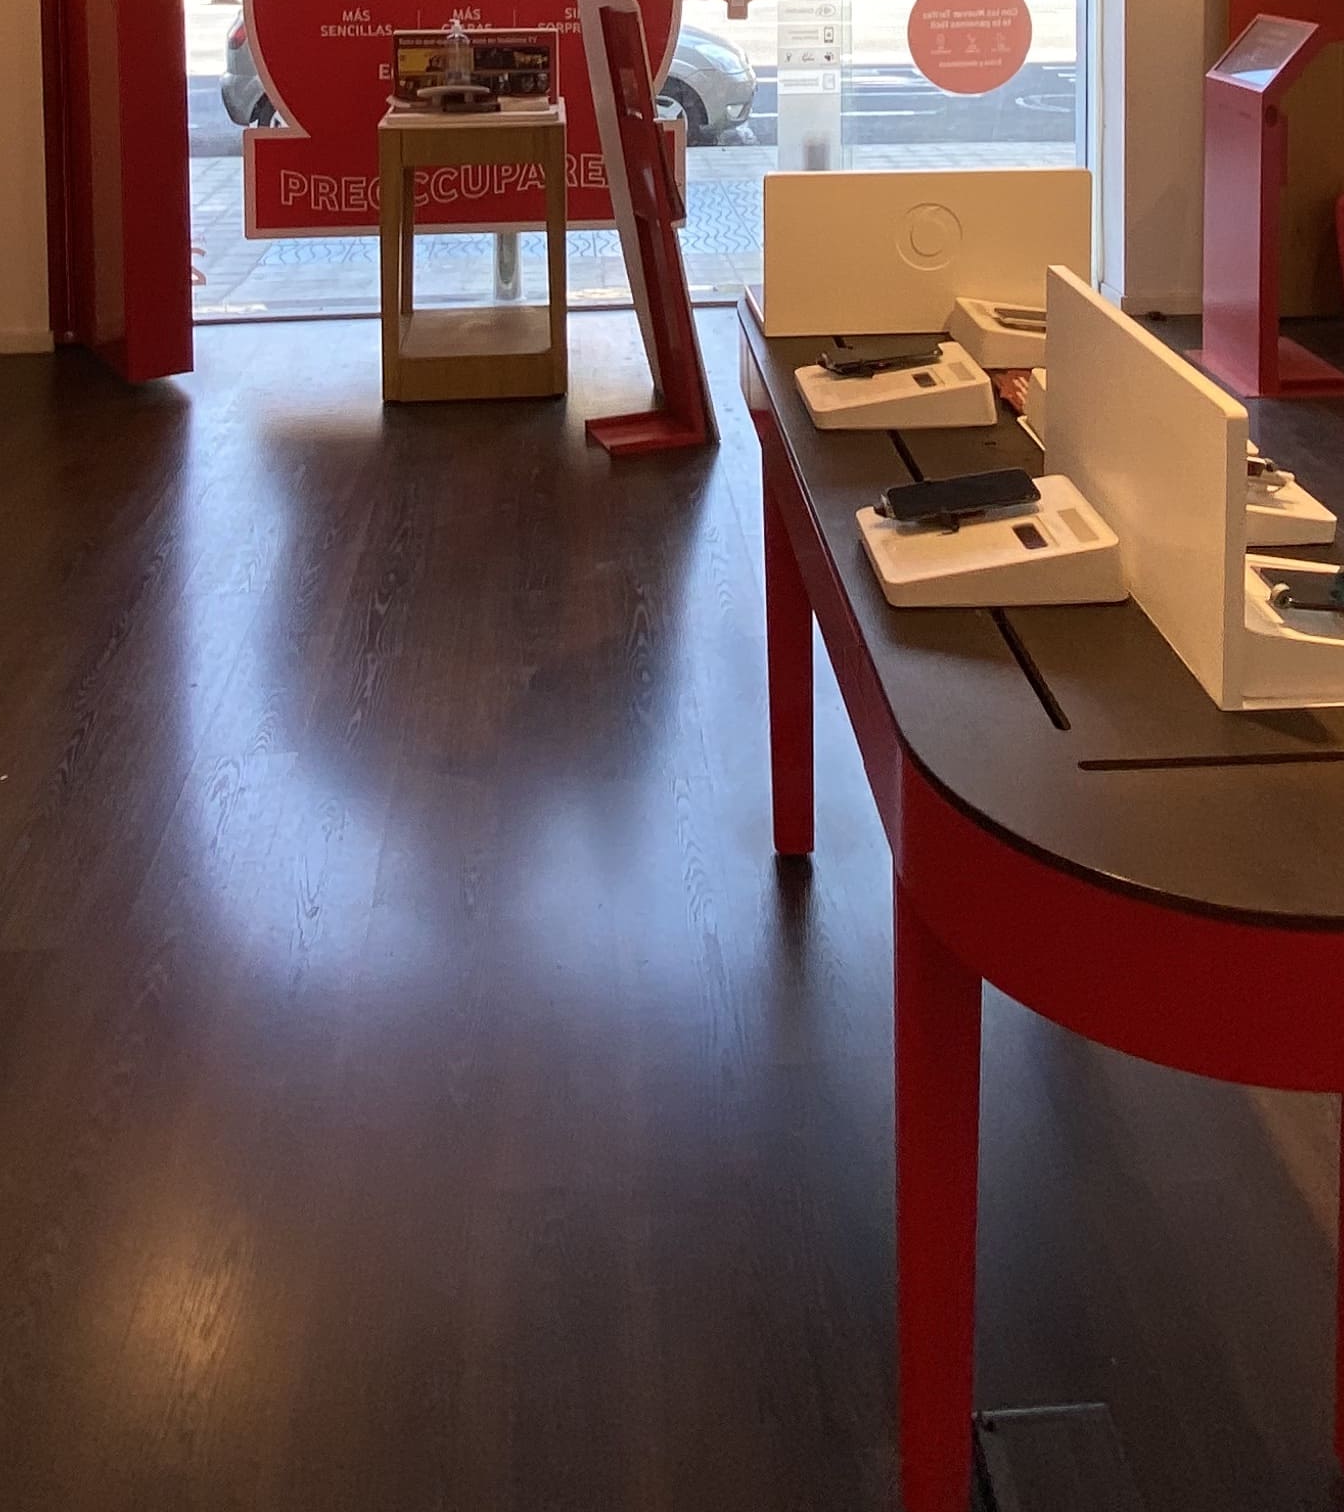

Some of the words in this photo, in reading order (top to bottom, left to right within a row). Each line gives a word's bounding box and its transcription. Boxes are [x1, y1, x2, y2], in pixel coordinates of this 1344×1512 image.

[342, 7, 371, 22] MÁS
[452, 6, 481, 22] MÁS
[564, 7, 580, 20] SI
[320, 23, 393, 38] SENCILLAS
